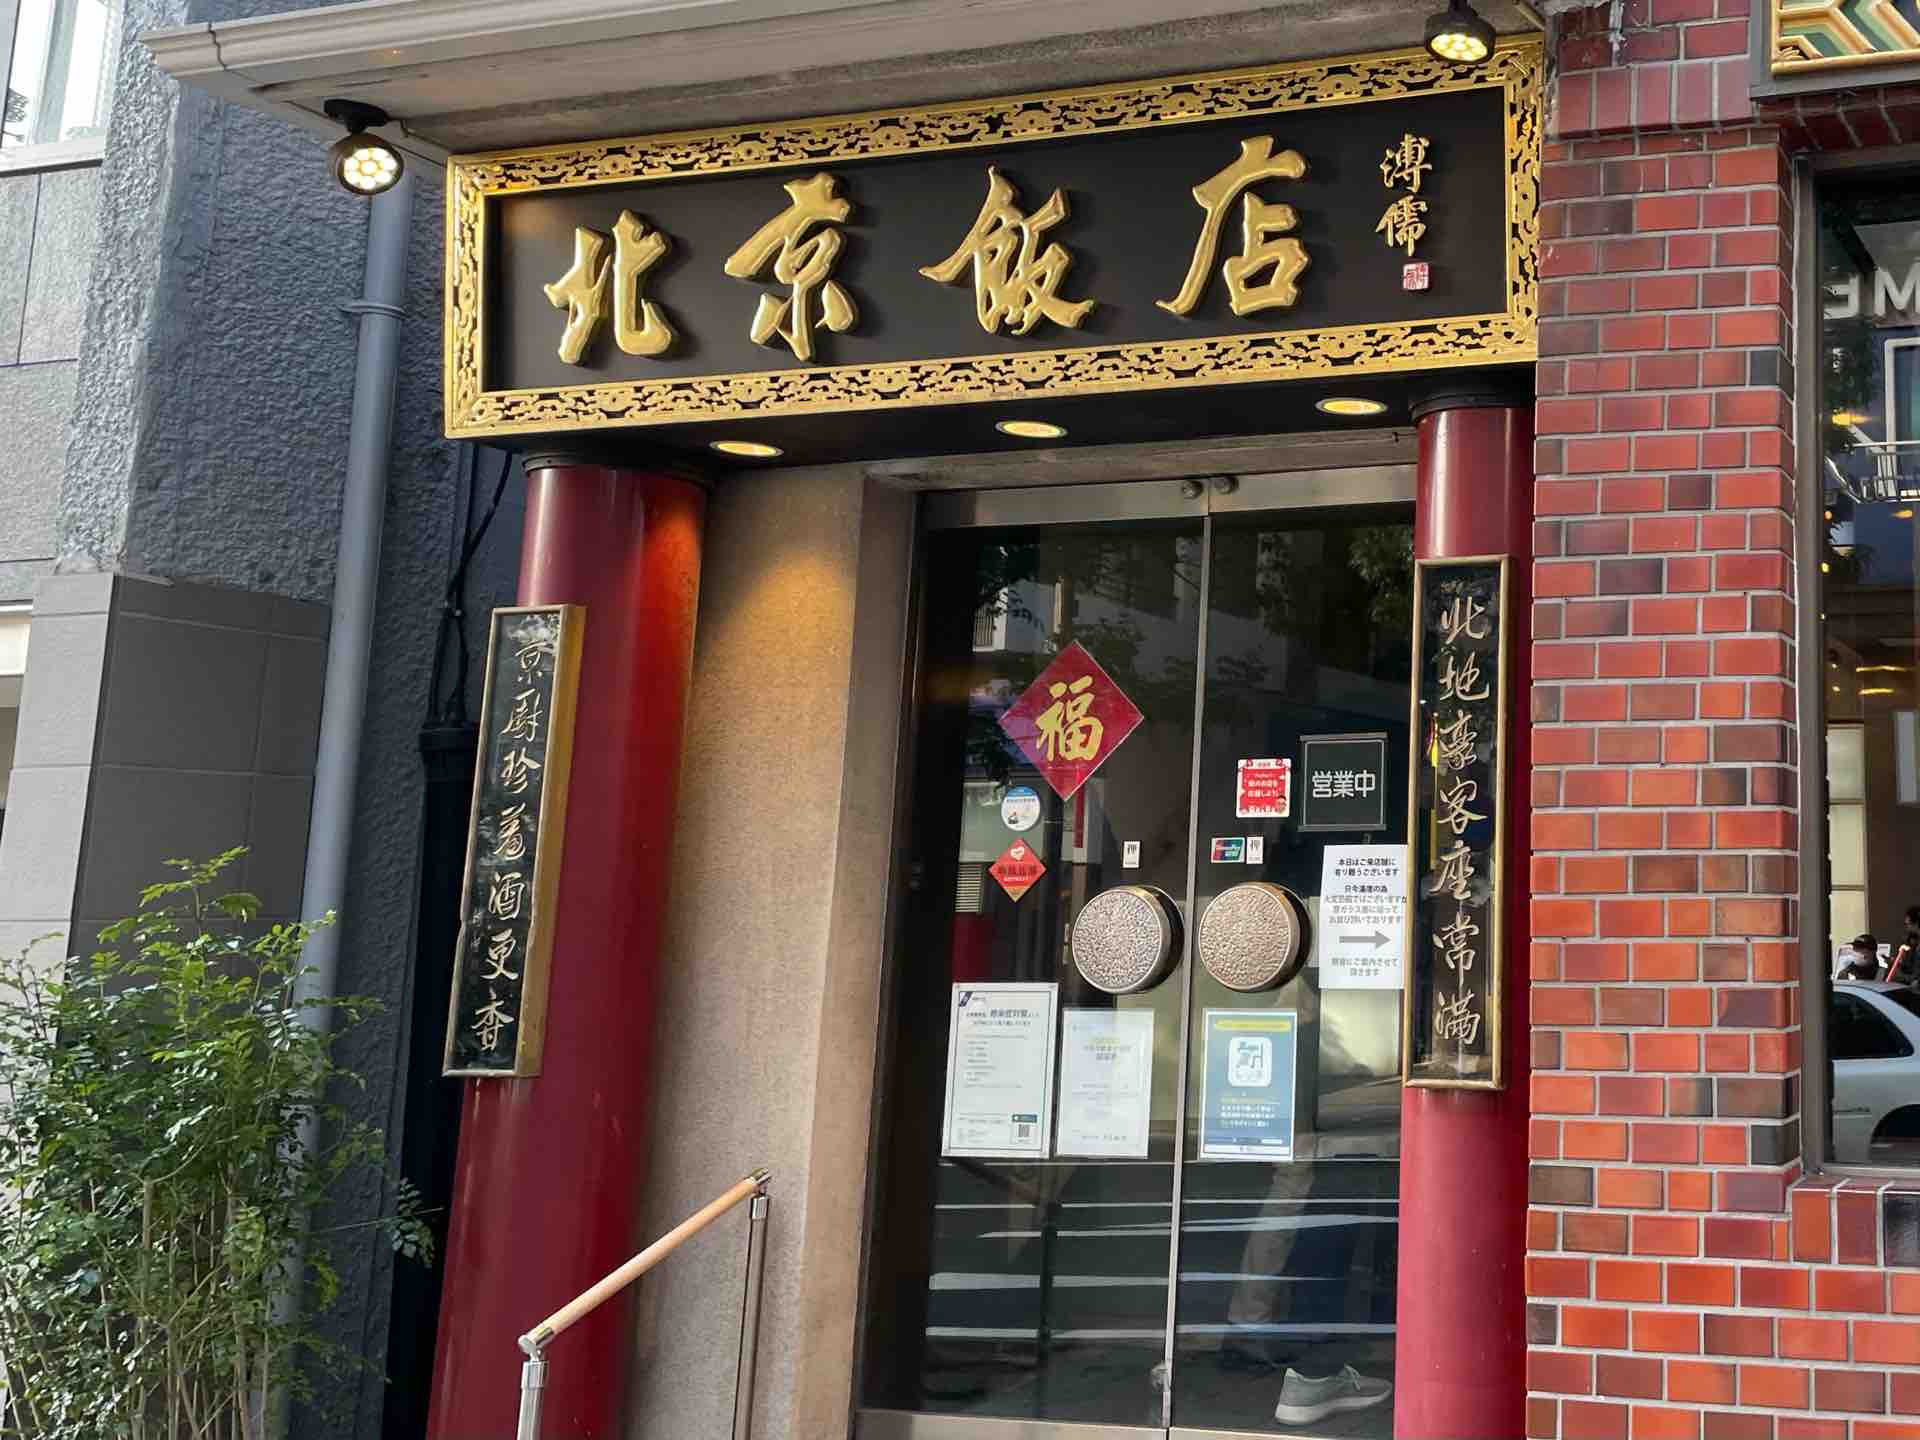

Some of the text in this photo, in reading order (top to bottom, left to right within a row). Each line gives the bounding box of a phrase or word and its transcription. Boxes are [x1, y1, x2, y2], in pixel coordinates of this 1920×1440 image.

[543, 135, 1309, 364] 北京飯店
[1034, 674, 1104, 762] 福
[1311, 769, 1376, 798] 営業中
